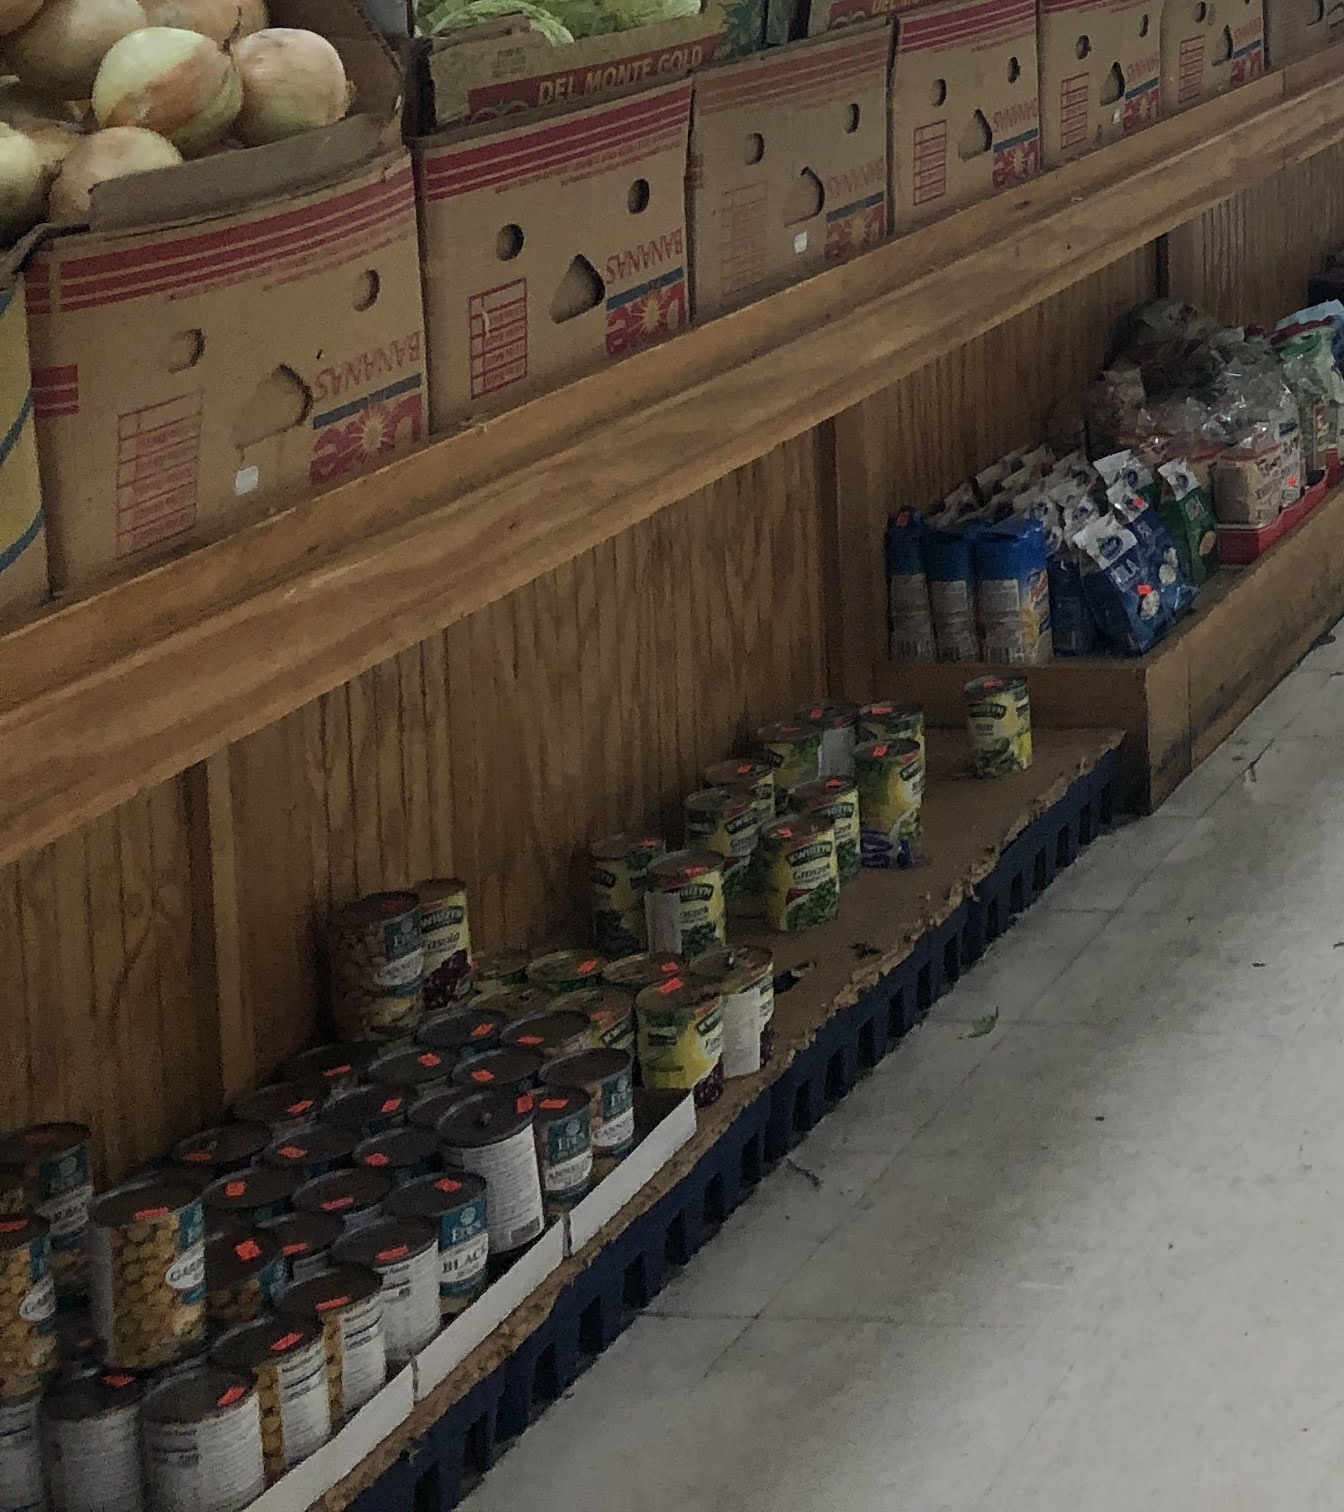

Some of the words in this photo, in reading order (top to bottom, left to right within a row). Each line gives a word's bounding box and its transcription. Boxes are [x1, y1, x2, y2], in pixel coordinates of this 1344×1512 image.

[537, 76, 576, 105] DEL
[584, 58, 652, 96] MONTE
[657, 45, 703, 75] GOLD
[605, 229, 684, 285] BANANAS
